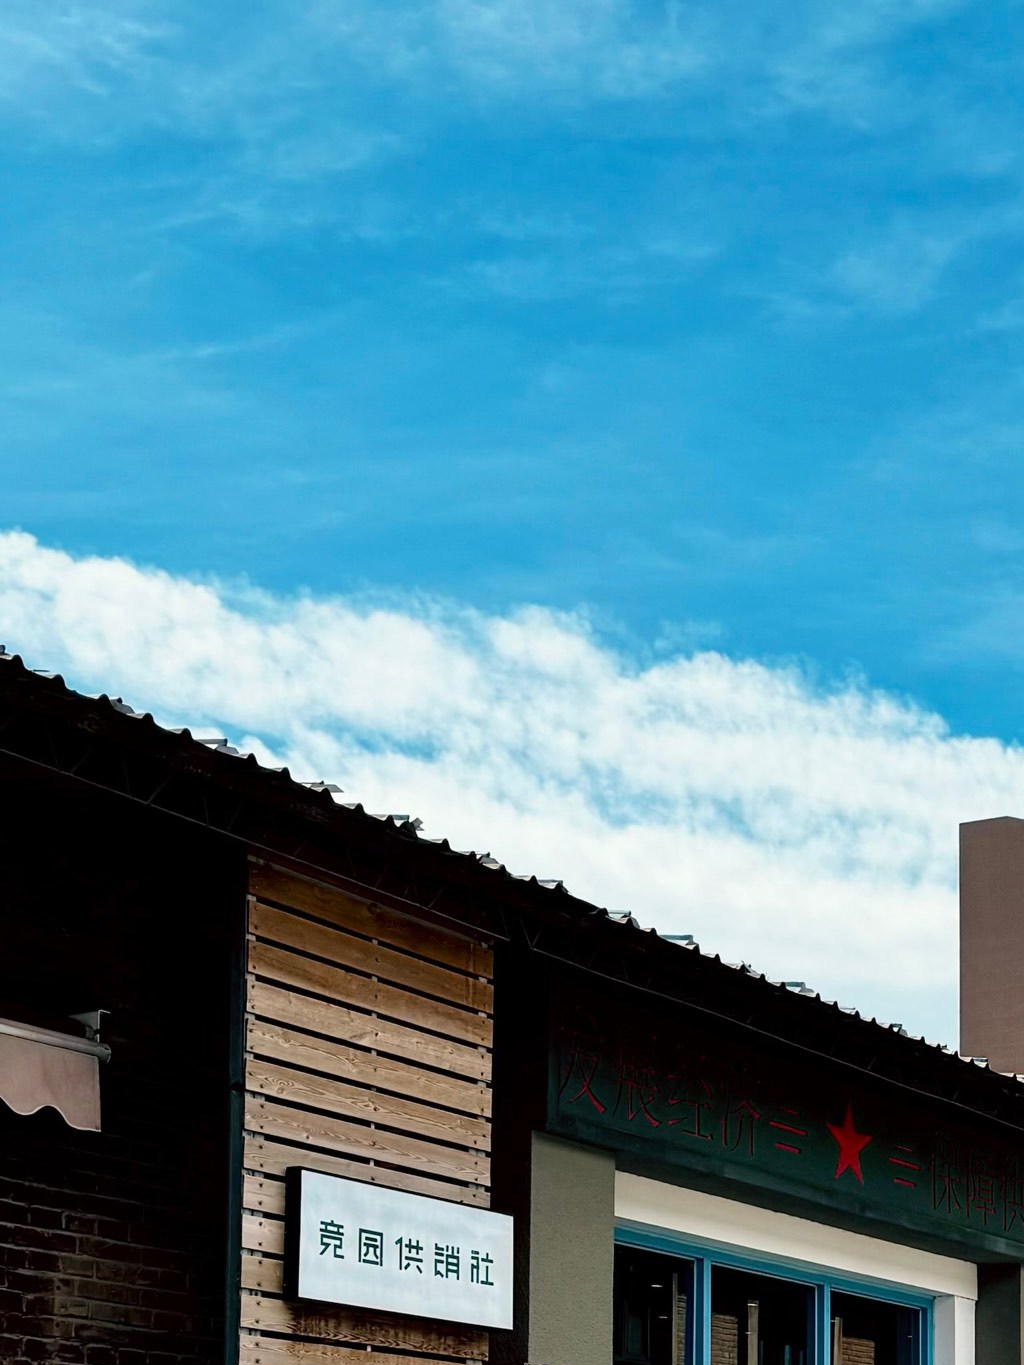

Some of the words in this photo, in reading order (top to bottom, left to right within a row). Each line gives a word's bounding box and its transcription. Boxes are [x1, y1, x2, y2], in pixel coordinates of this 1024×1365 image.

[319, 1219, 494, 1287] 竞园供销社
